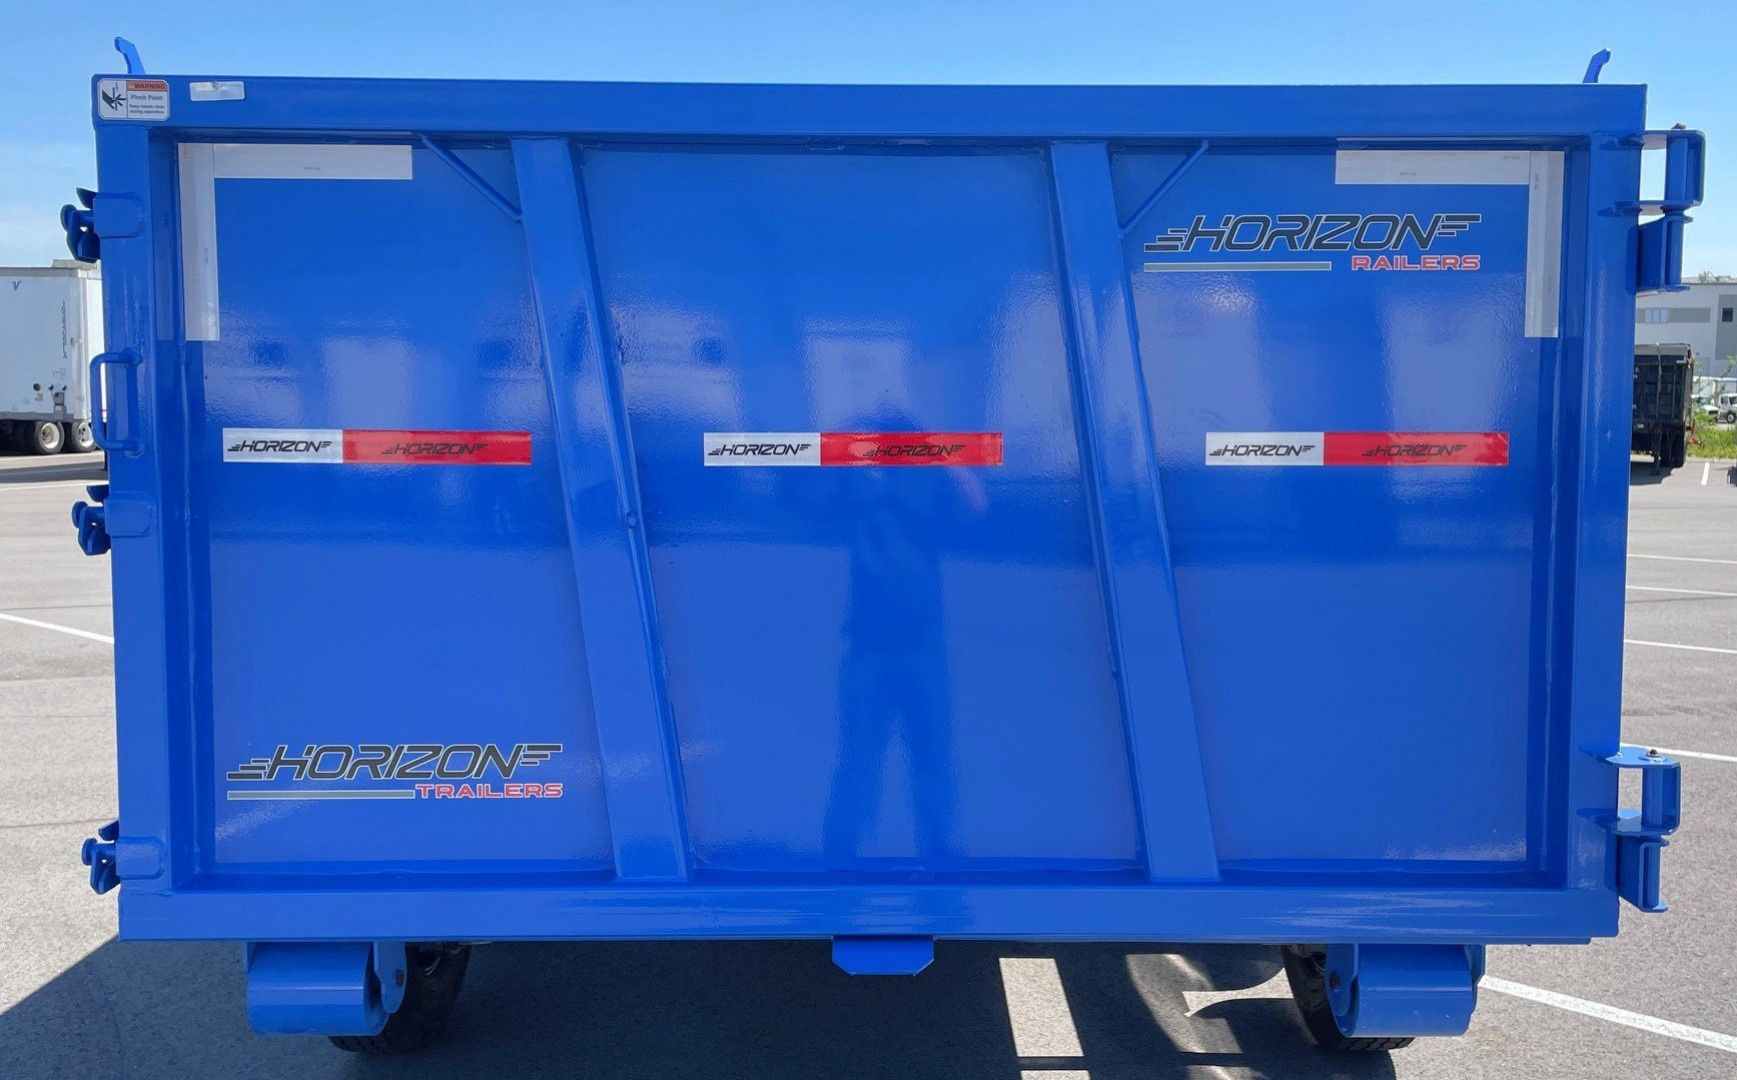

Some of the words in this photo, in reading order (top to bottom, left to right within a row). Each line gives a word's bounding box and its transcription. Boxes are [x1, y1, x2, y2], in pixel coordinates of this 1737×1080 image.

[1182, 213, 1450, 252] HORIZON
[1351, 255, 1482, 271] RAILERS
[237, 440, 322, 453] HORIZON
[390, 442, 478, 455] HORIZON
[719, 443, 801, 456] HORIZON
[874, 444, 957, 457] HORIZON
[1221, 444, 1304, 457] HORIZON
[1372, 444, 1456, 457] HORIZON
[265, 743, 526, 781] HORIZON
[414, 783, 564, 799] TRAILERS
